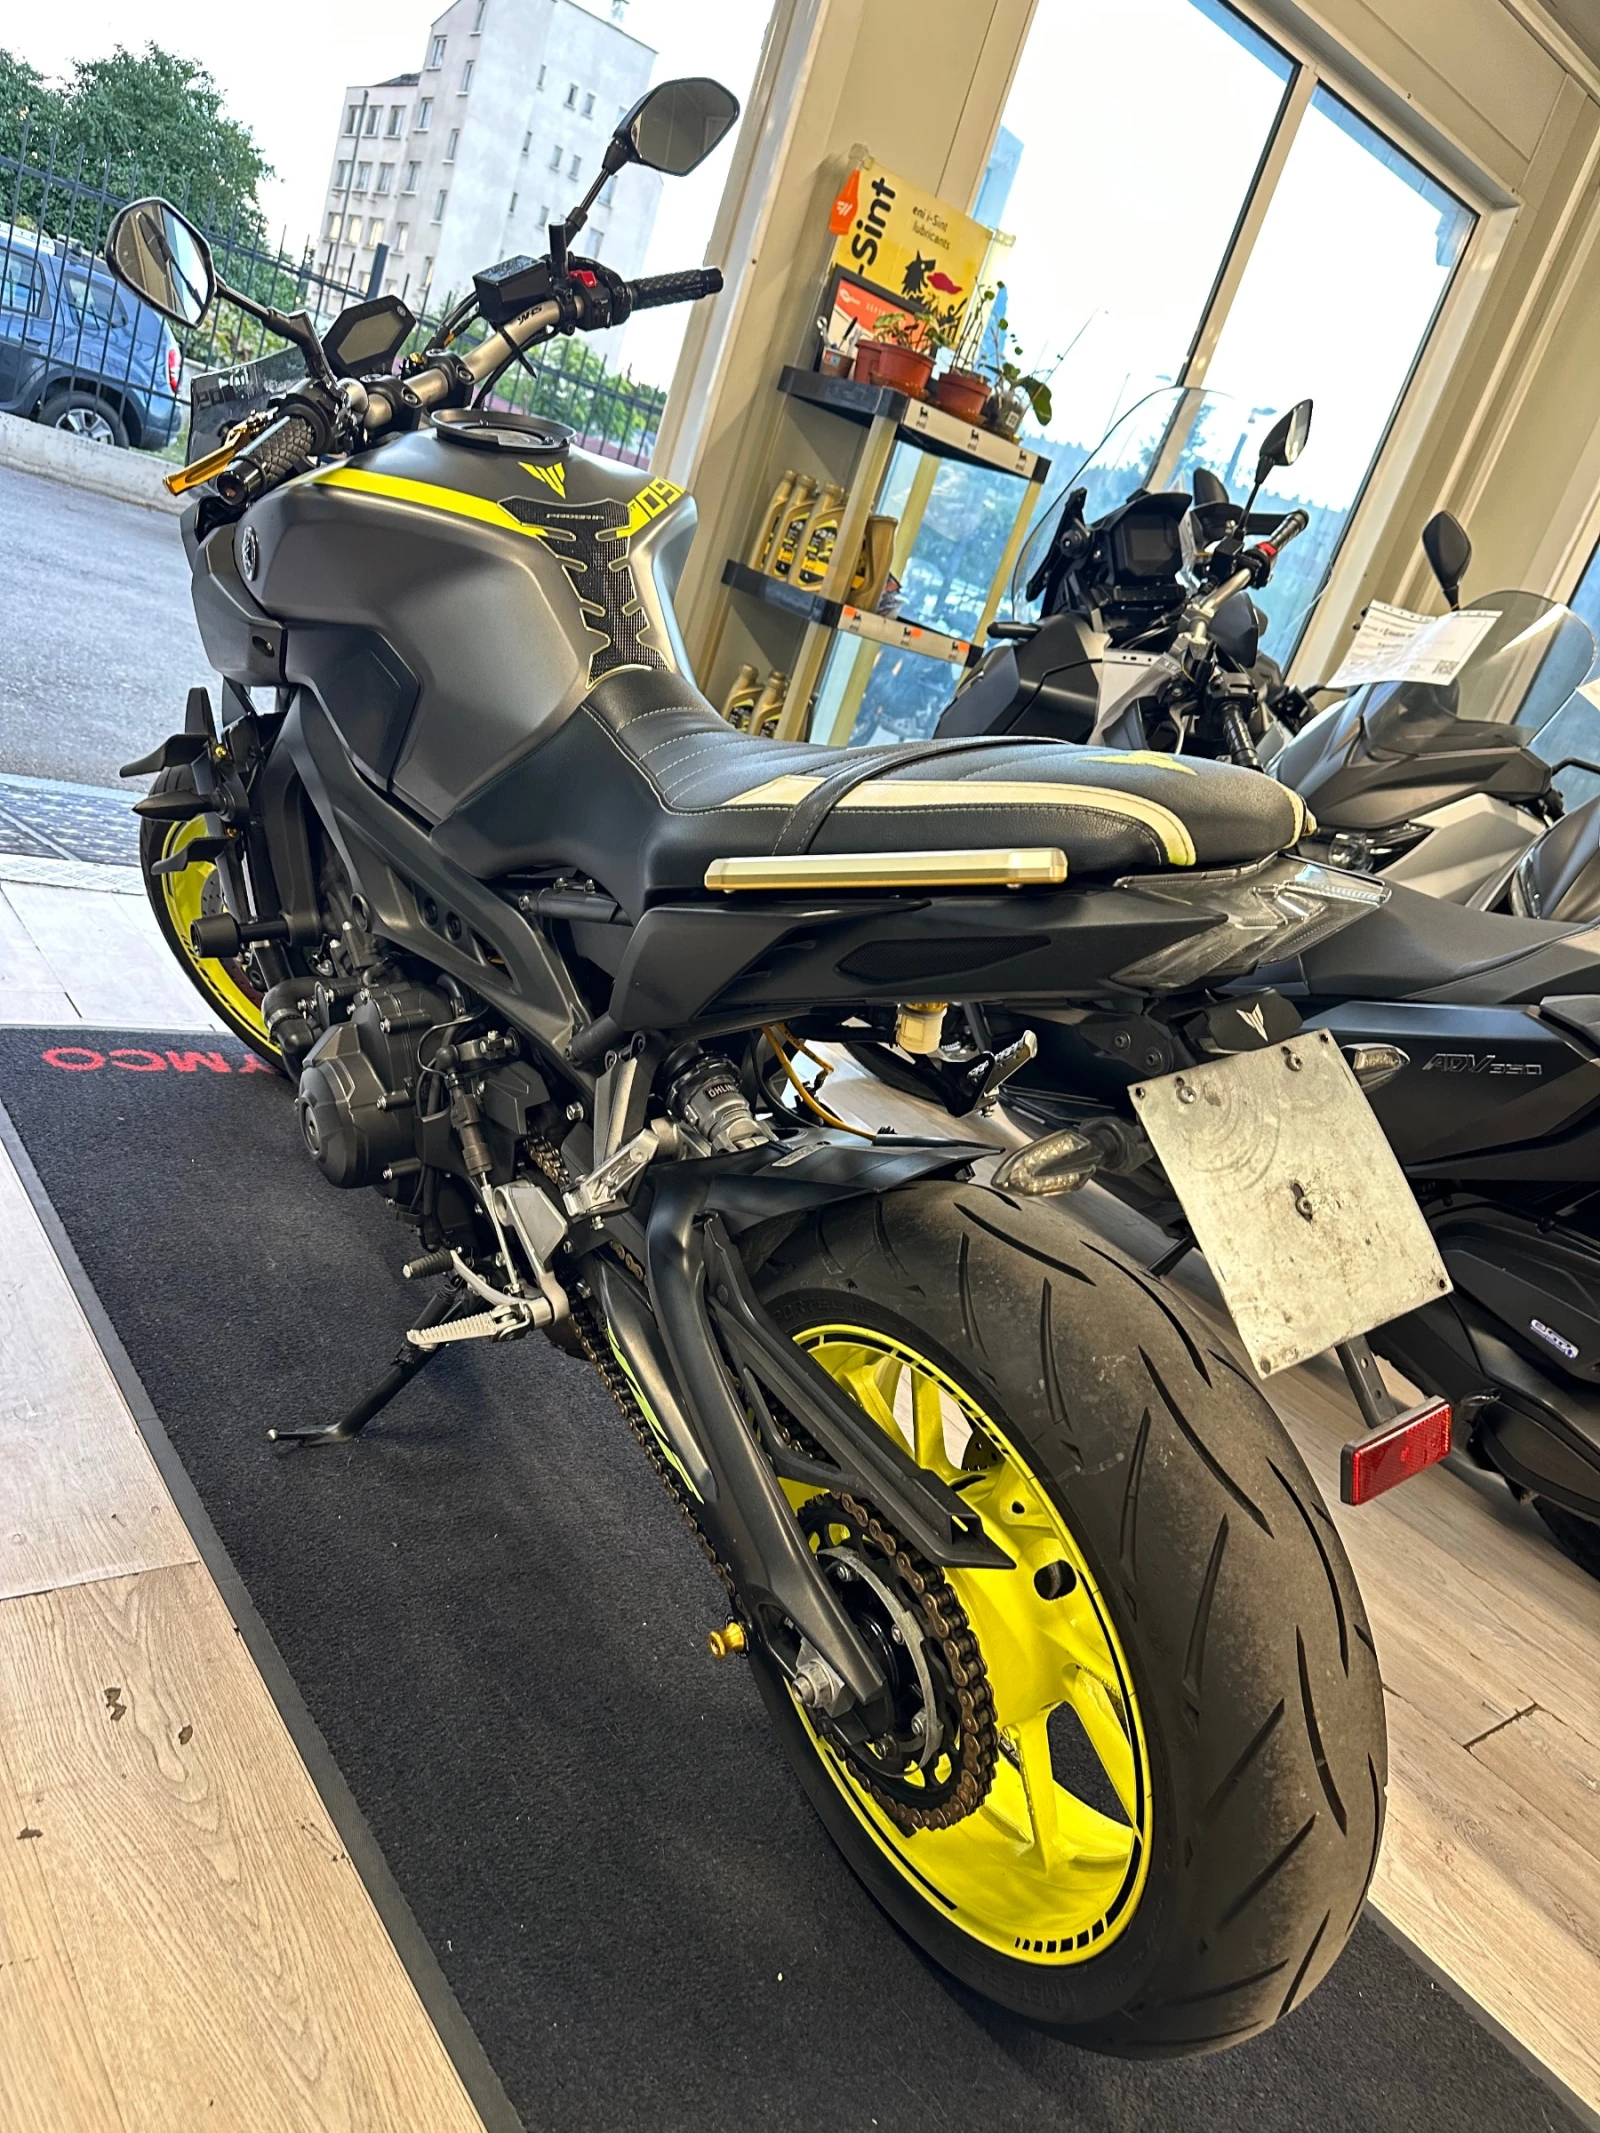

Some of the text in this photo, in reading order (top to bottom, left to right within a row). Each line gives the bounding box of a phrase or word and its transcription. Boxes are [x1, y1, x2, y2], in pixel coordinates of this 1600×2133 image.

[851, 177, 896, 276] -Sint
[912, 221, 951, 250] lubricants
[636, 477, 682, 518] 09
[42, 1047, 276, 1074] YMCO
